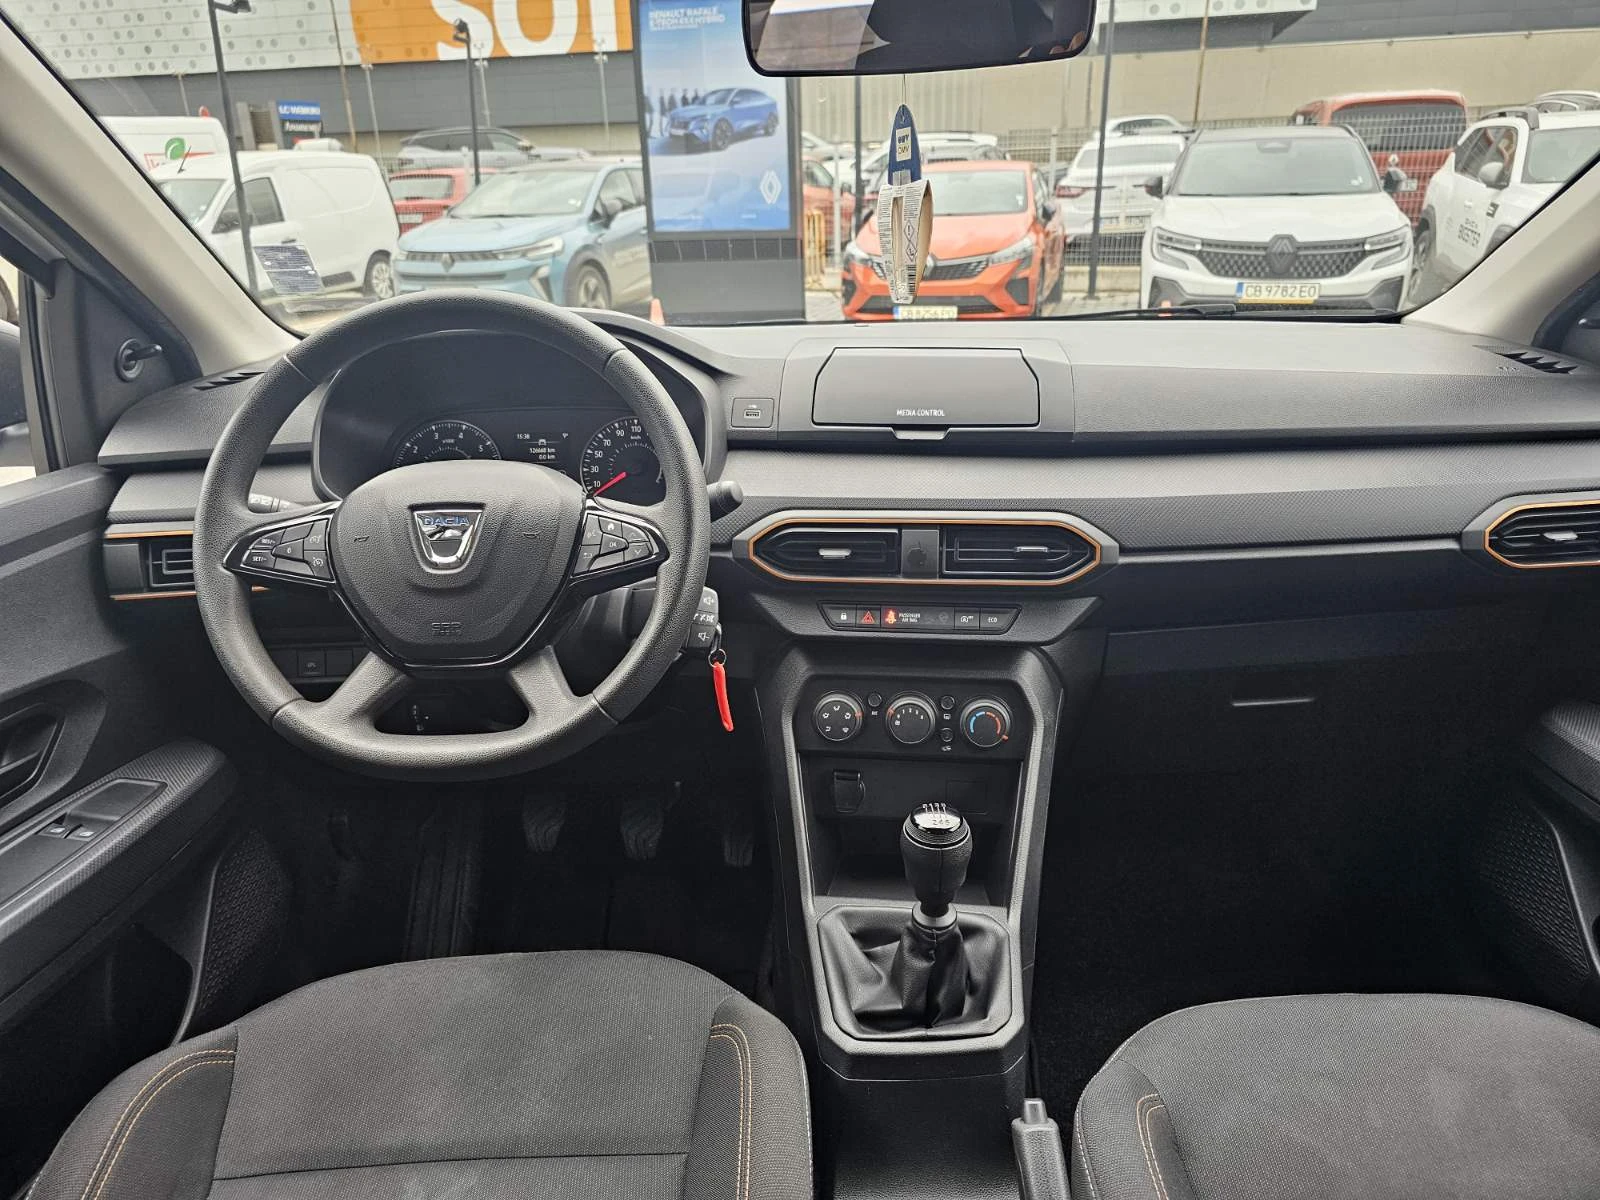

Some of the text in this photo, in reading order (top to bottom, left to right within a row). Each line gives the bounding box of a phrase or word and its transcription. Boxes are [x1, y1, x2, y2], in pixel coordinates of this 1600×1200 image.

[896, 409, 945, 417] MEDIA CONTROL
[616, 429, 625, 437] 90
[631, 425, 642, 433] 110
[434, 432, 439, 440] 3
[603, 439, 611, 447] 70
[594, 450, 603, 458] 50
[590, 465, 599, 473] 30
[593, 480, 601, 488] 10
[424, 517, 469, 526] DACIA
